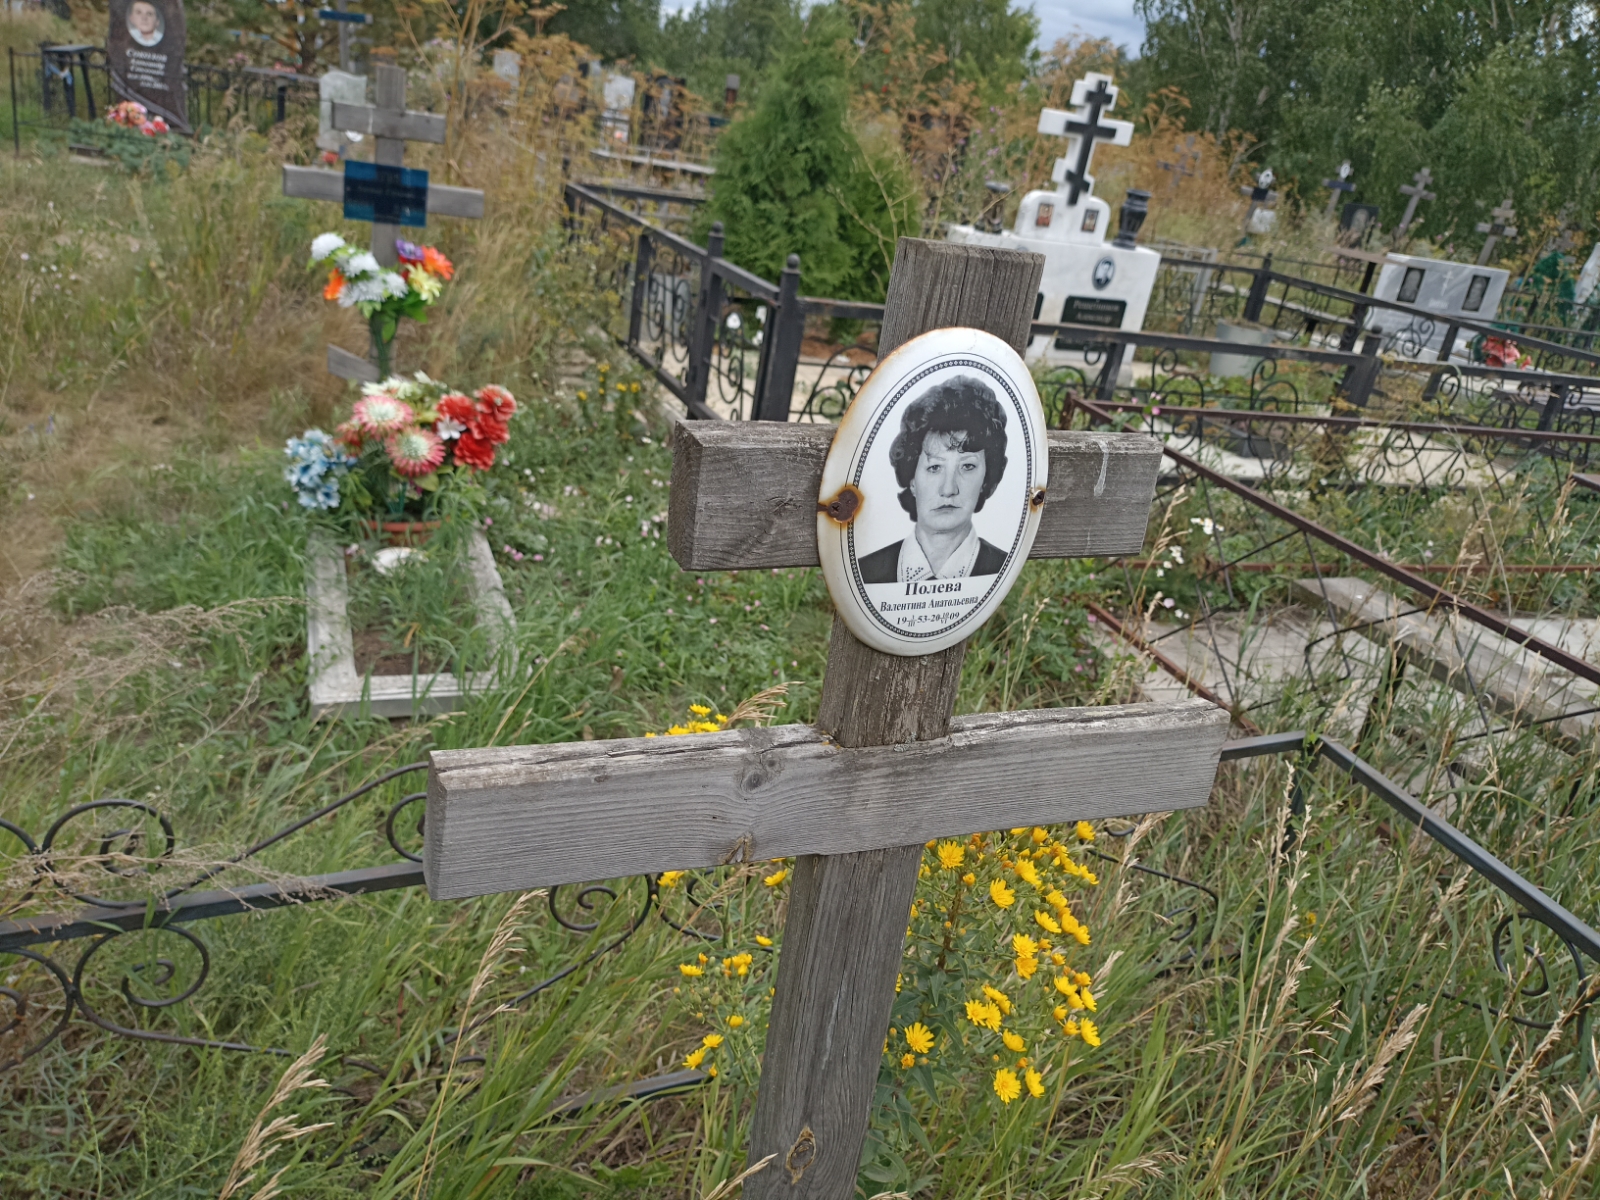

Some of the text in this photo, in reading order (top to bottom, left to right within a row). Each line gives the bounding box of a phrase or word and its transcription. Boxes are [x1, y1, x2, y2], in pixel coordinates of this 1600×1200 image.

[905, 582, 962, 596] Полева
[880, 596, 979, 612] Валентина Анатольевна
